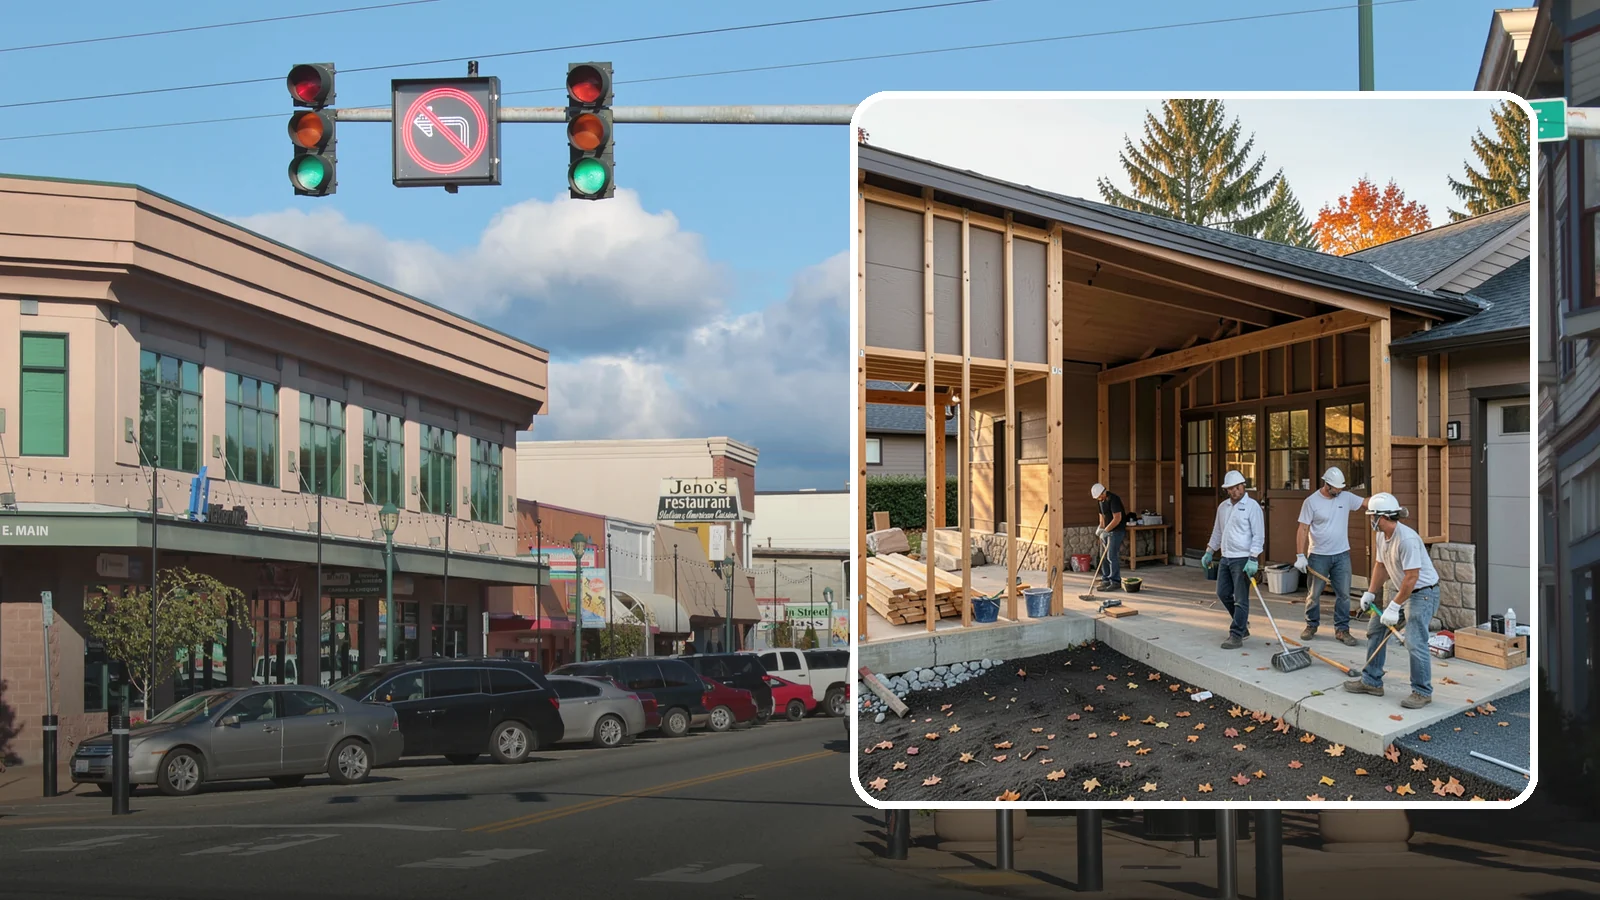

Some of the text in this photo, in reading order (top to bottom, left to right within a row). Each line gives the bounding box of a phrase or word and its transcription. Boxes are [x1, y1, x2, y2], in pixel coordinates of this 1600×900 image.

[670, 480, 728, 494] Jeno's
[665, 496, 731, 509] restaurant
[658, 510, 682, 520] Italian
[686, 509, 714, 520] American
[714, 509, 738, 520] Cuisine
[2, 525, 49, 537] E. MAIN
